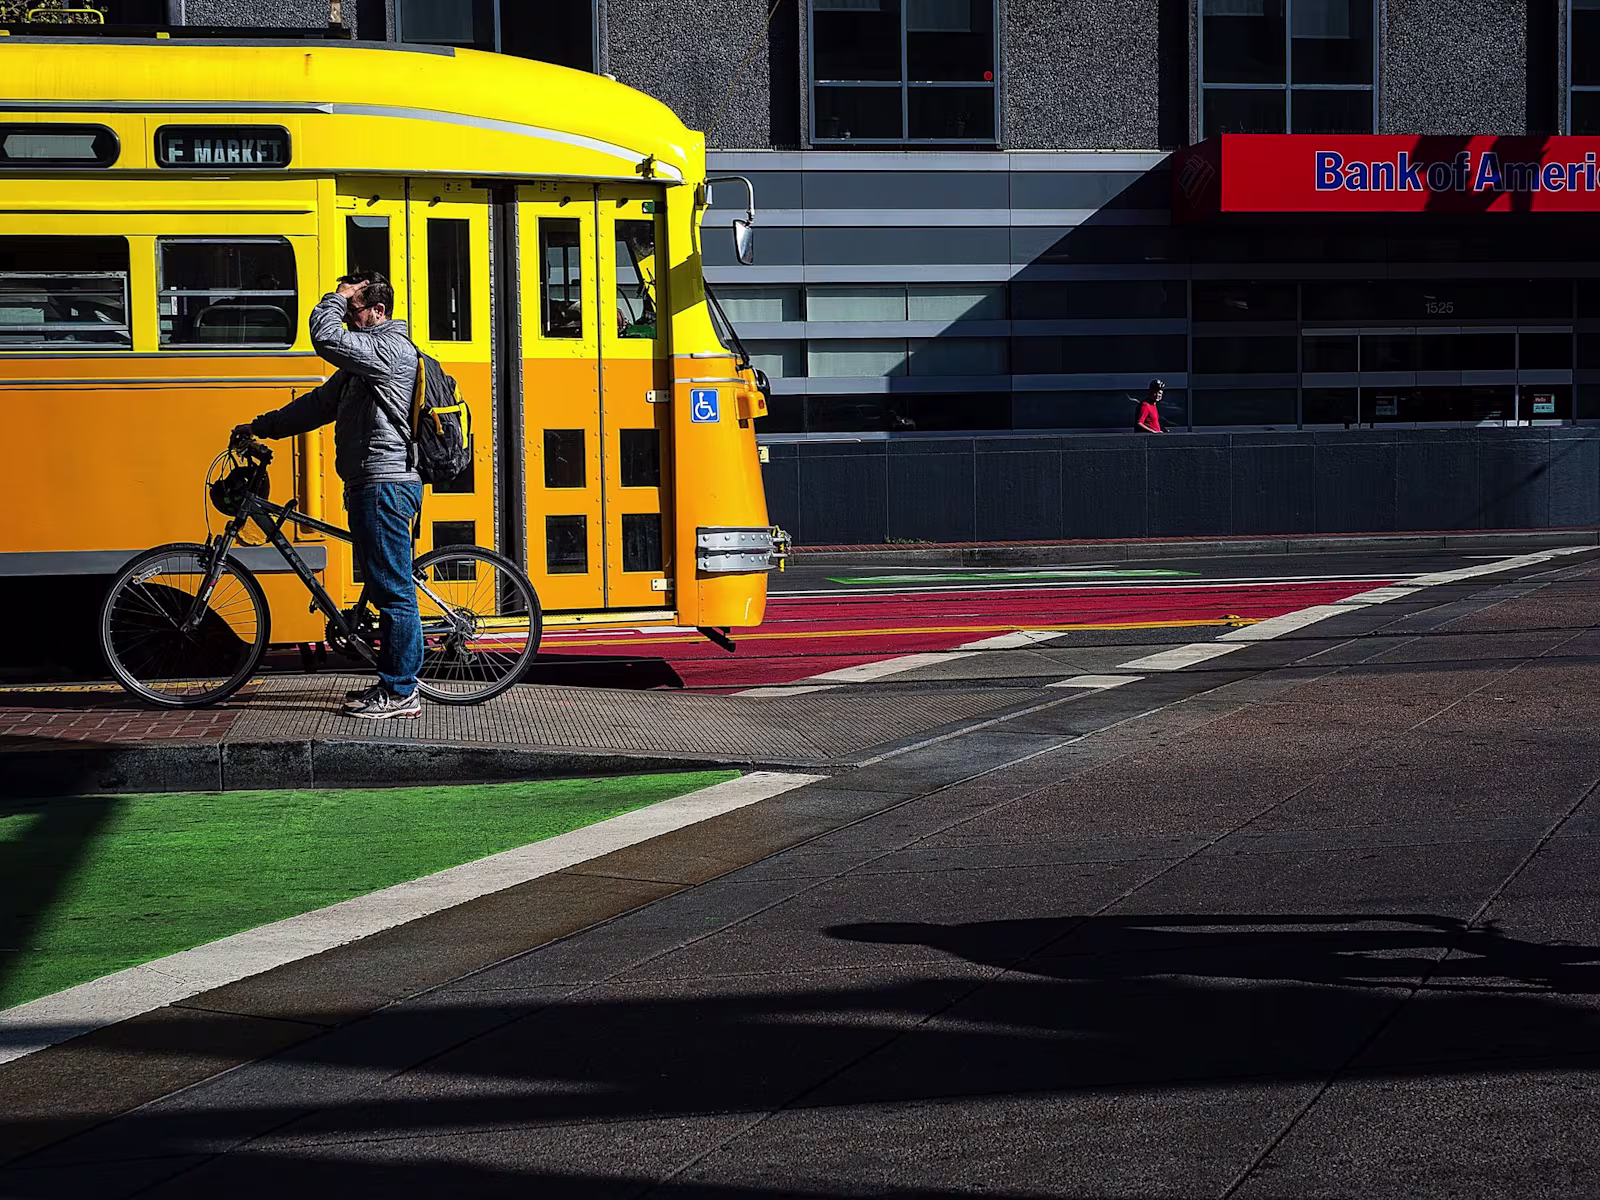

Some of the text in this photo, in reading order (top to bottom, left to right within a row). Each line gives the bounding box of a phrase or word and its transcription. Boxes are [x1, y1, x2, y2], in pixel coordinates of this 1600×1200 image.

[168, 139, 281, 163] F MARKET
[1315, 151, 1600, 192] Bank of Ameri
[1425, 301, 1454, 314] 1525
